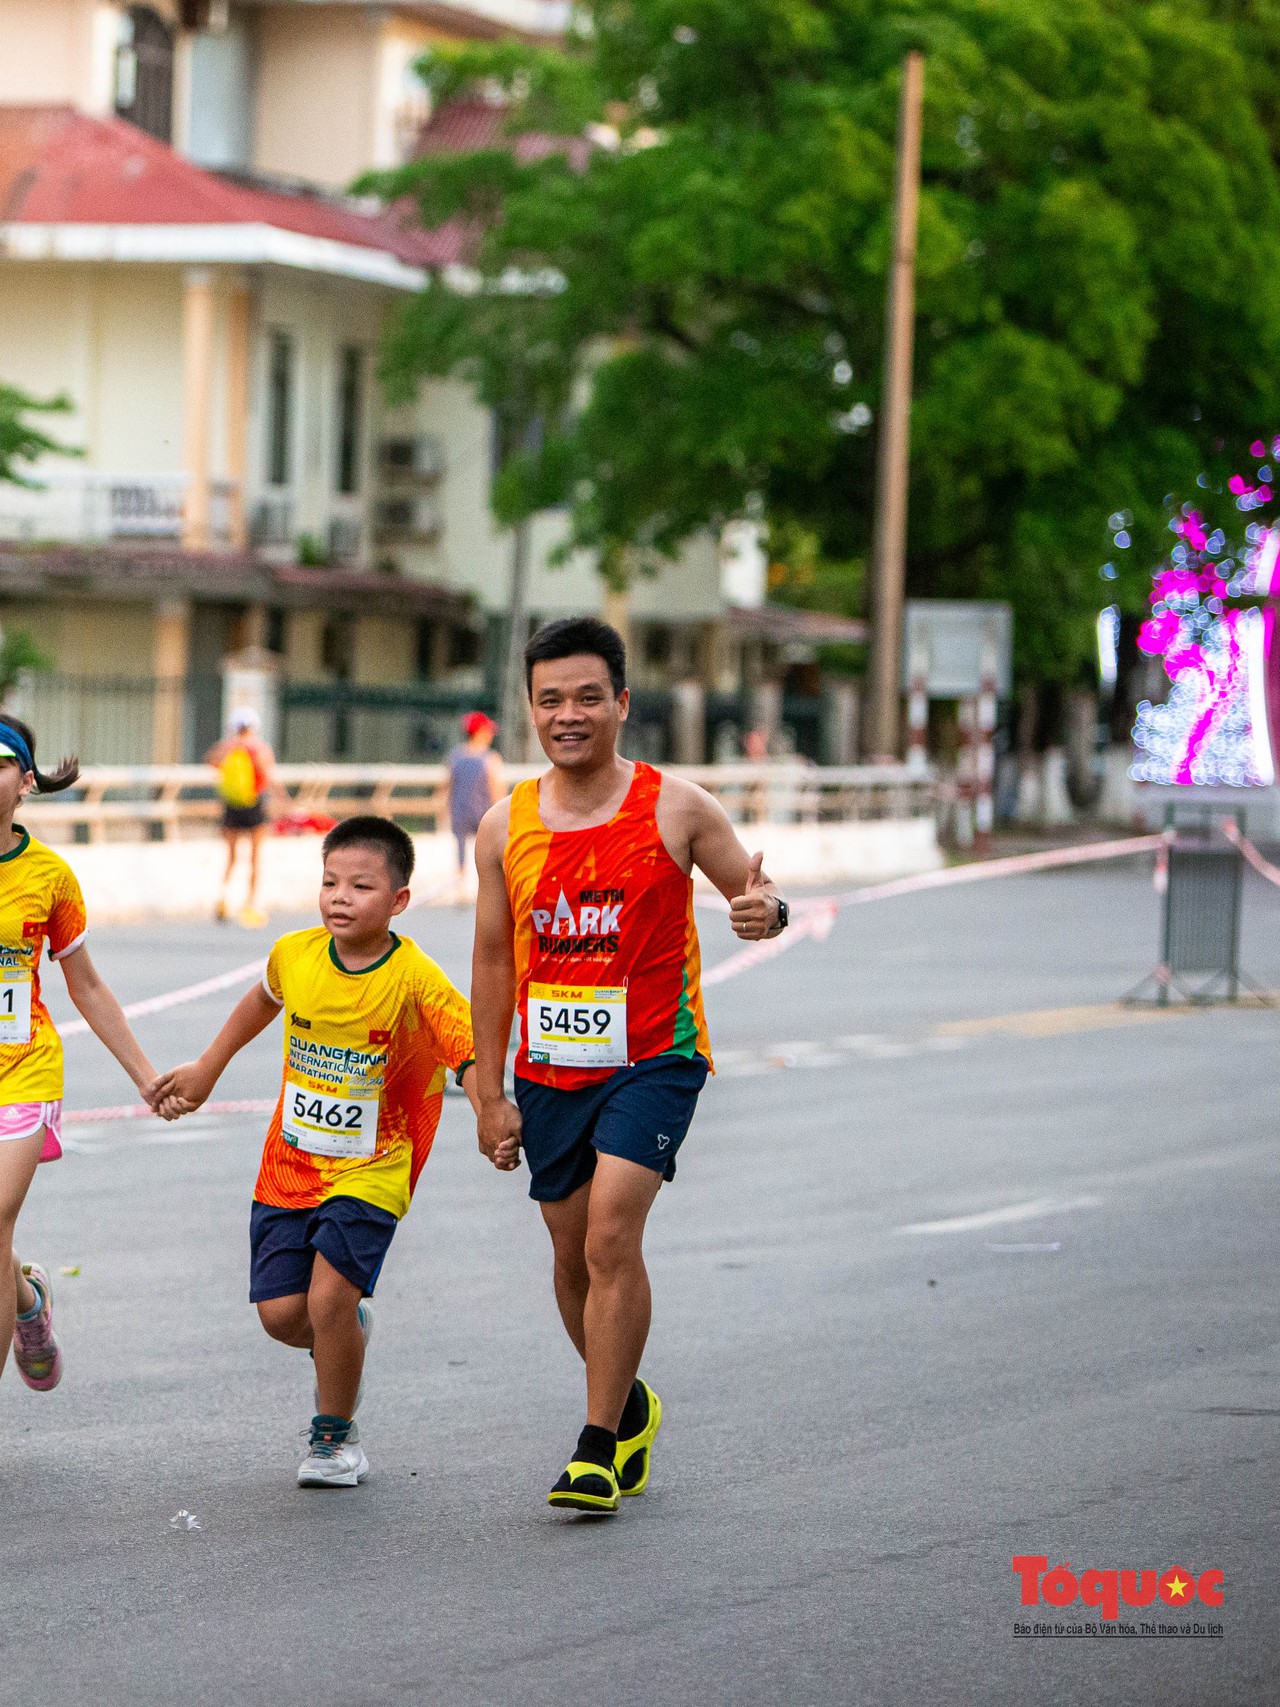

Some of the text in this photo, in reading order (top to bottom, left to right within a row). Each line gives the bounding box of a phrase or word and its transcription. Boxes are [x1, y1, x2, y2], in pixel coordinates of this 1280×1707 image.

[531, 883, 624, 936] PARK
[538, 935, 620, 954] RUNNERS
[551, 989, 583, 999] 5KM
[540, 1006, 611, 1035] 5459
[289, 1060, 344, 1084] MARATHON
[290, 1048, 368, 1077] INTERNATIONAL
[308, 1080, 338, 1094] 5KM
[293, 1092, 363, 1129] 5462
